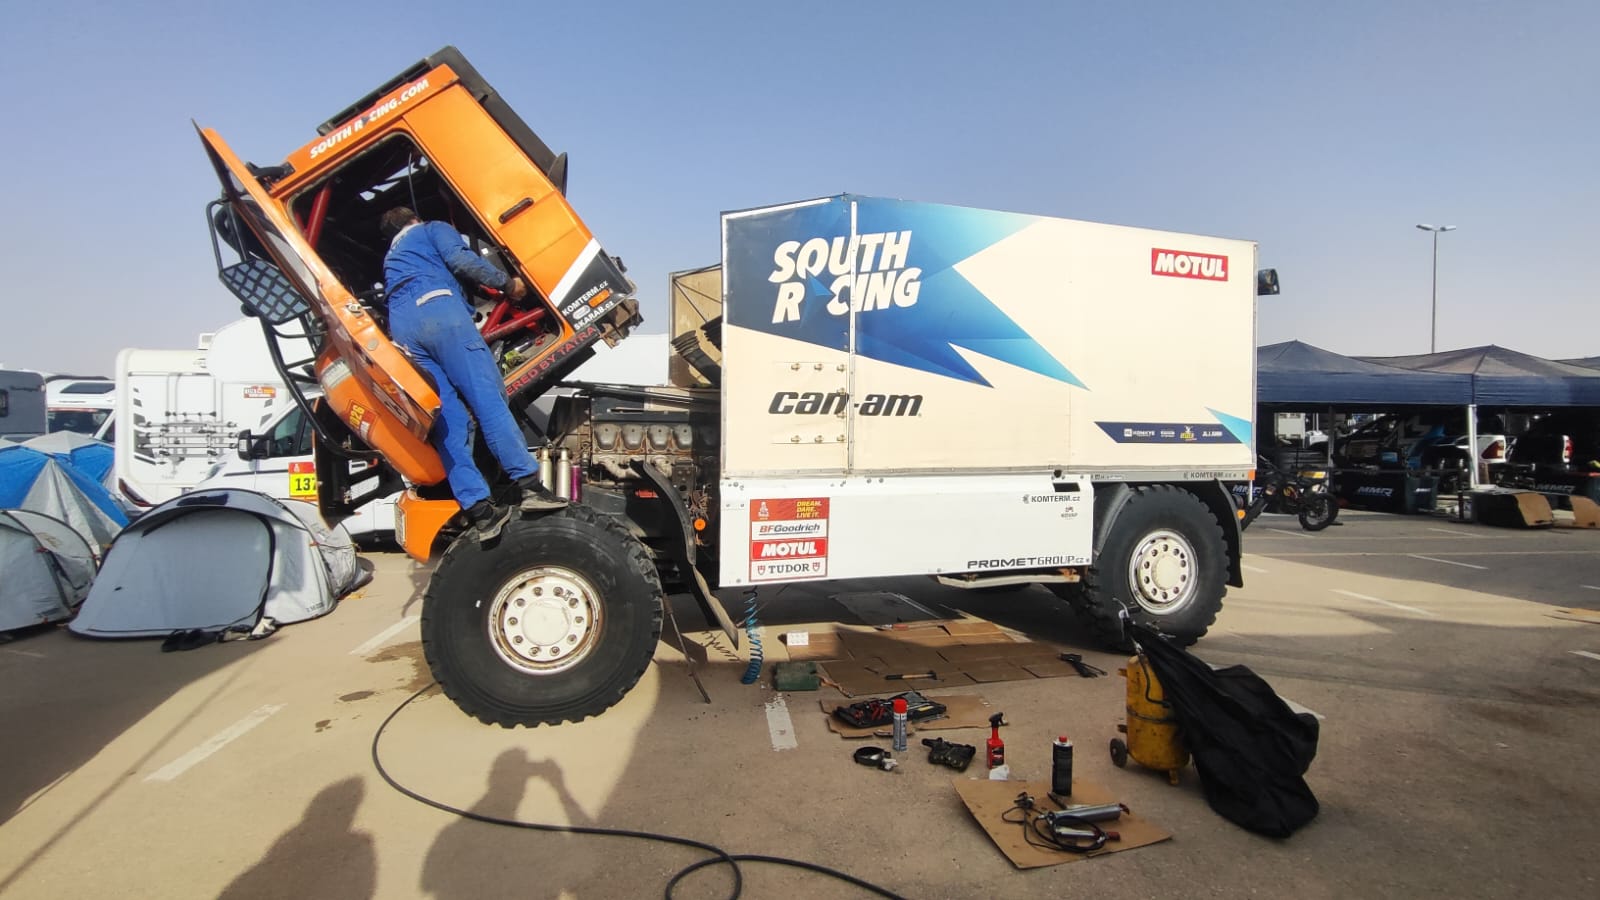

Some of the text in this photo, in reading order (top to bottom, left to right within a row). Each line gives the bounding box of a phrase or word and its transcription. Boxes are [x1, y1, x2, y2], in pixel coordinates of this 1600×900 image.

[310, 125, 352, 159] SOUTH
[768, 230, 912, 284] SOUTH
[1154, 252, 1225, 278] MOTUL
[505, 326, 597, 396] ERED BY TATRA
[760, 523, 820, 533] BFGoodrich
[761, 541, 817, 557] MOTUL
[768, 563, 810, 574] TUDOR
